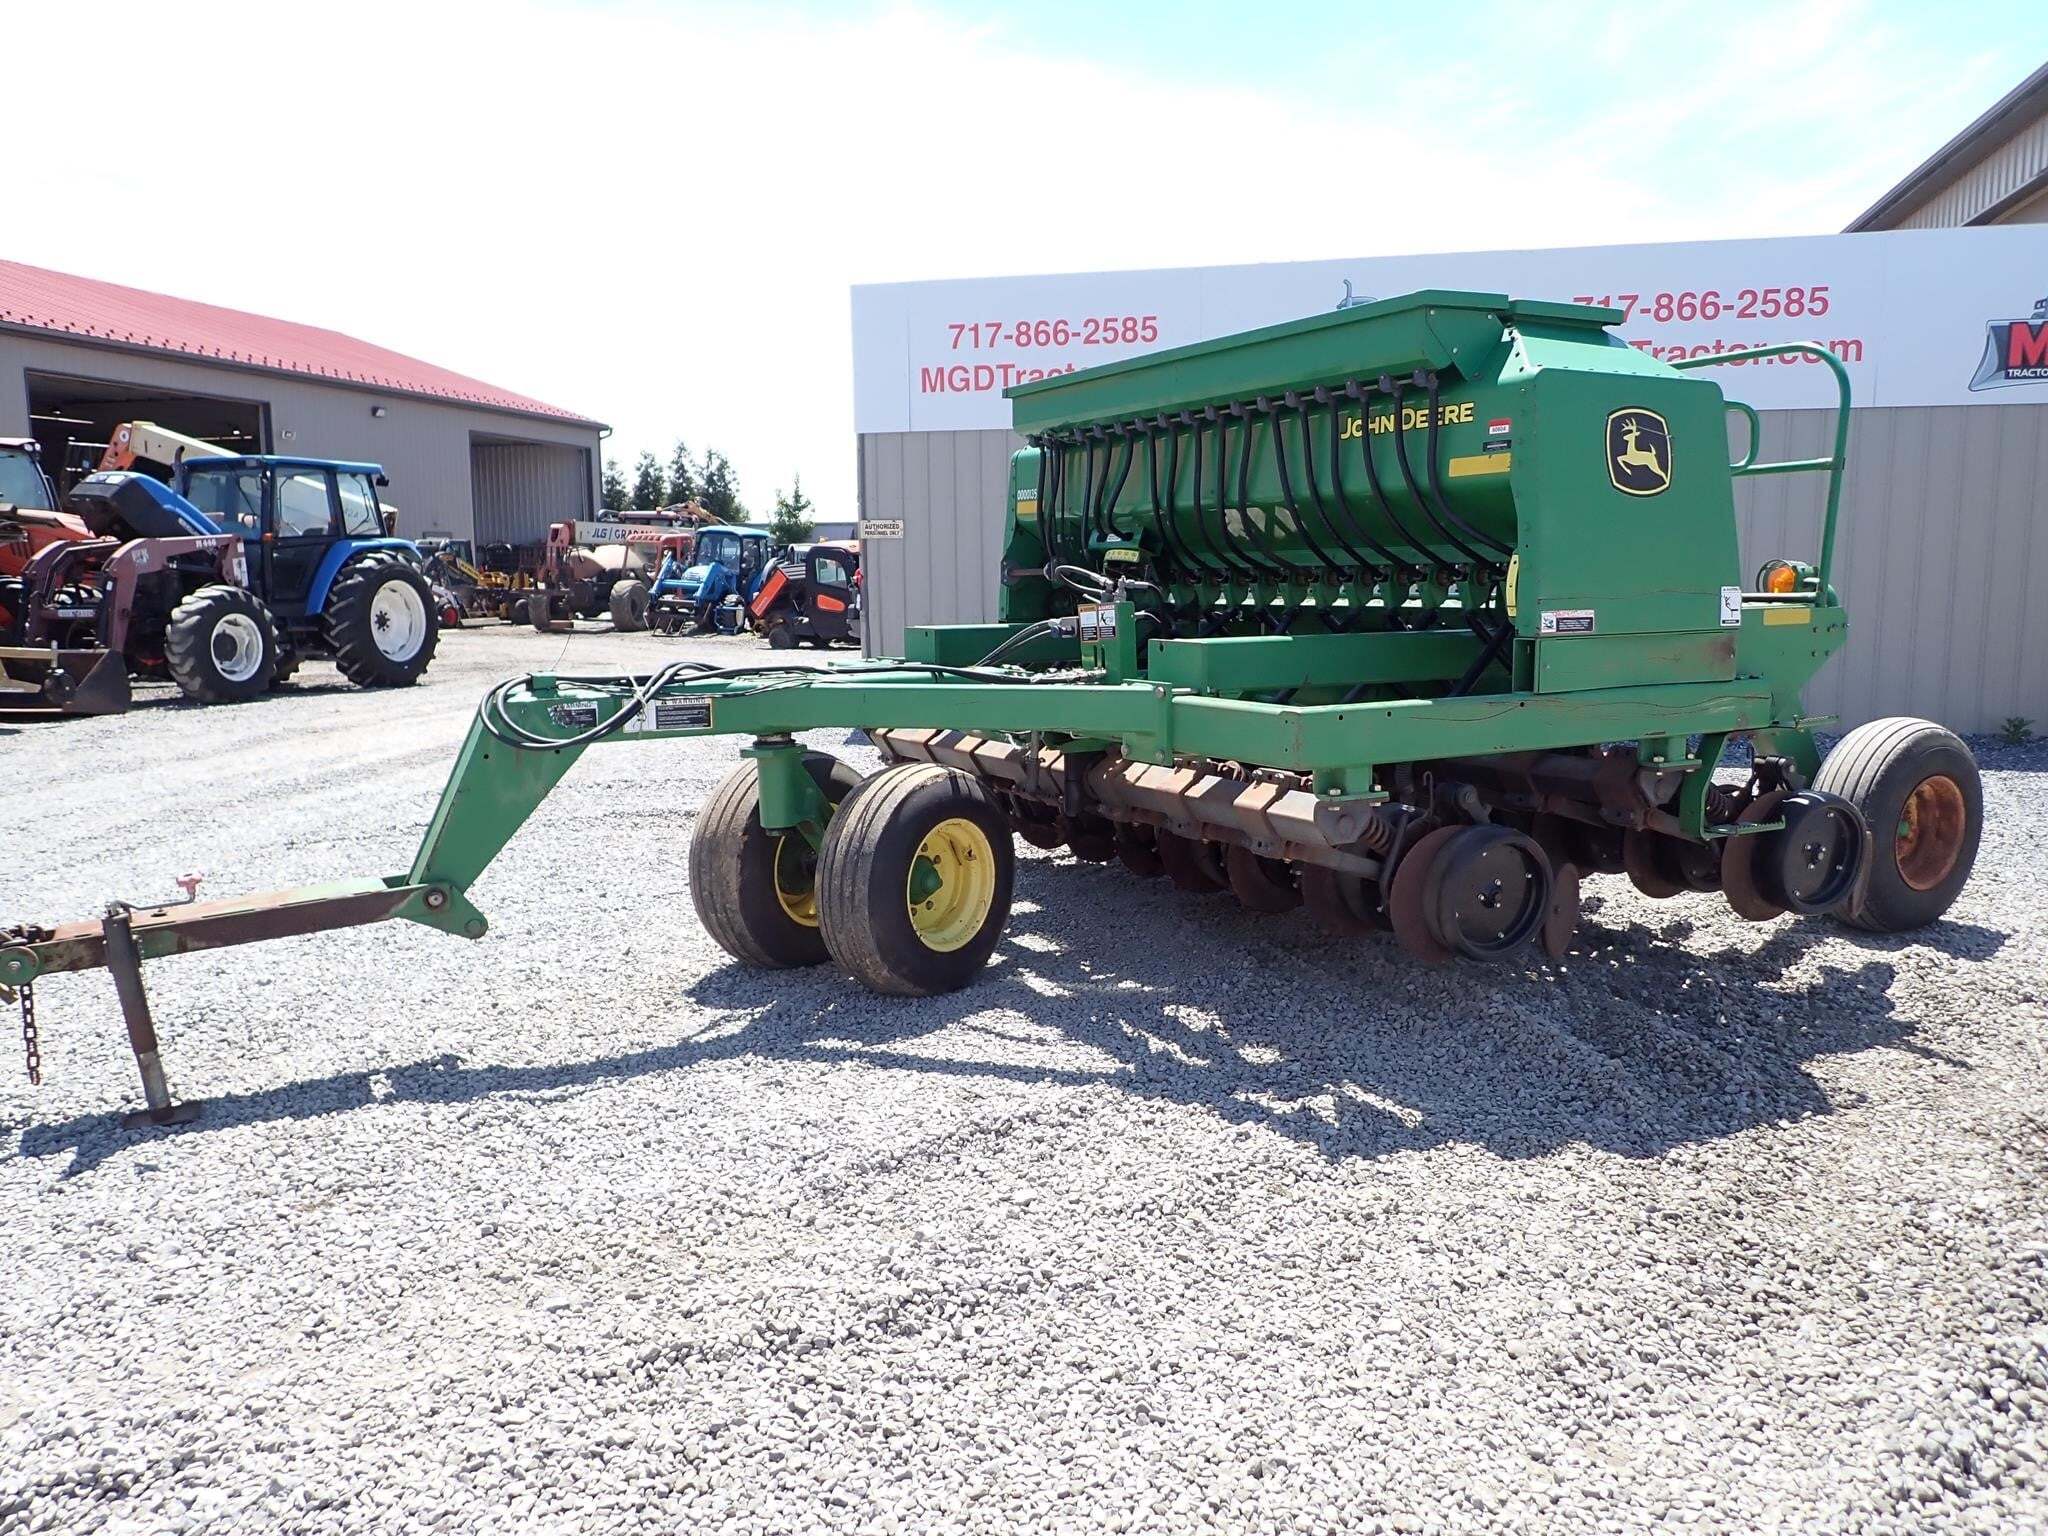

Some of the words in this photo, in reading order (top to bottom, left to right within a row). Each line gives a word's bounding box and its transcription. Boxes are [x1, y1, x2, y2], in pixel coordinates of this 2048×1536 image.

[1573, 287, 1829, 323] 7-866-2585
[948, 316, 1158, 349] 717-866-2585
[2008, 321, 2048, 367] M
[1628, 338, 1863, 366] Tractor.com
[2007, 368, 2048, 378] TRACTO
[1340, 414, 1395, 440] JOHN
[592, 528, 607, 538] JLG
